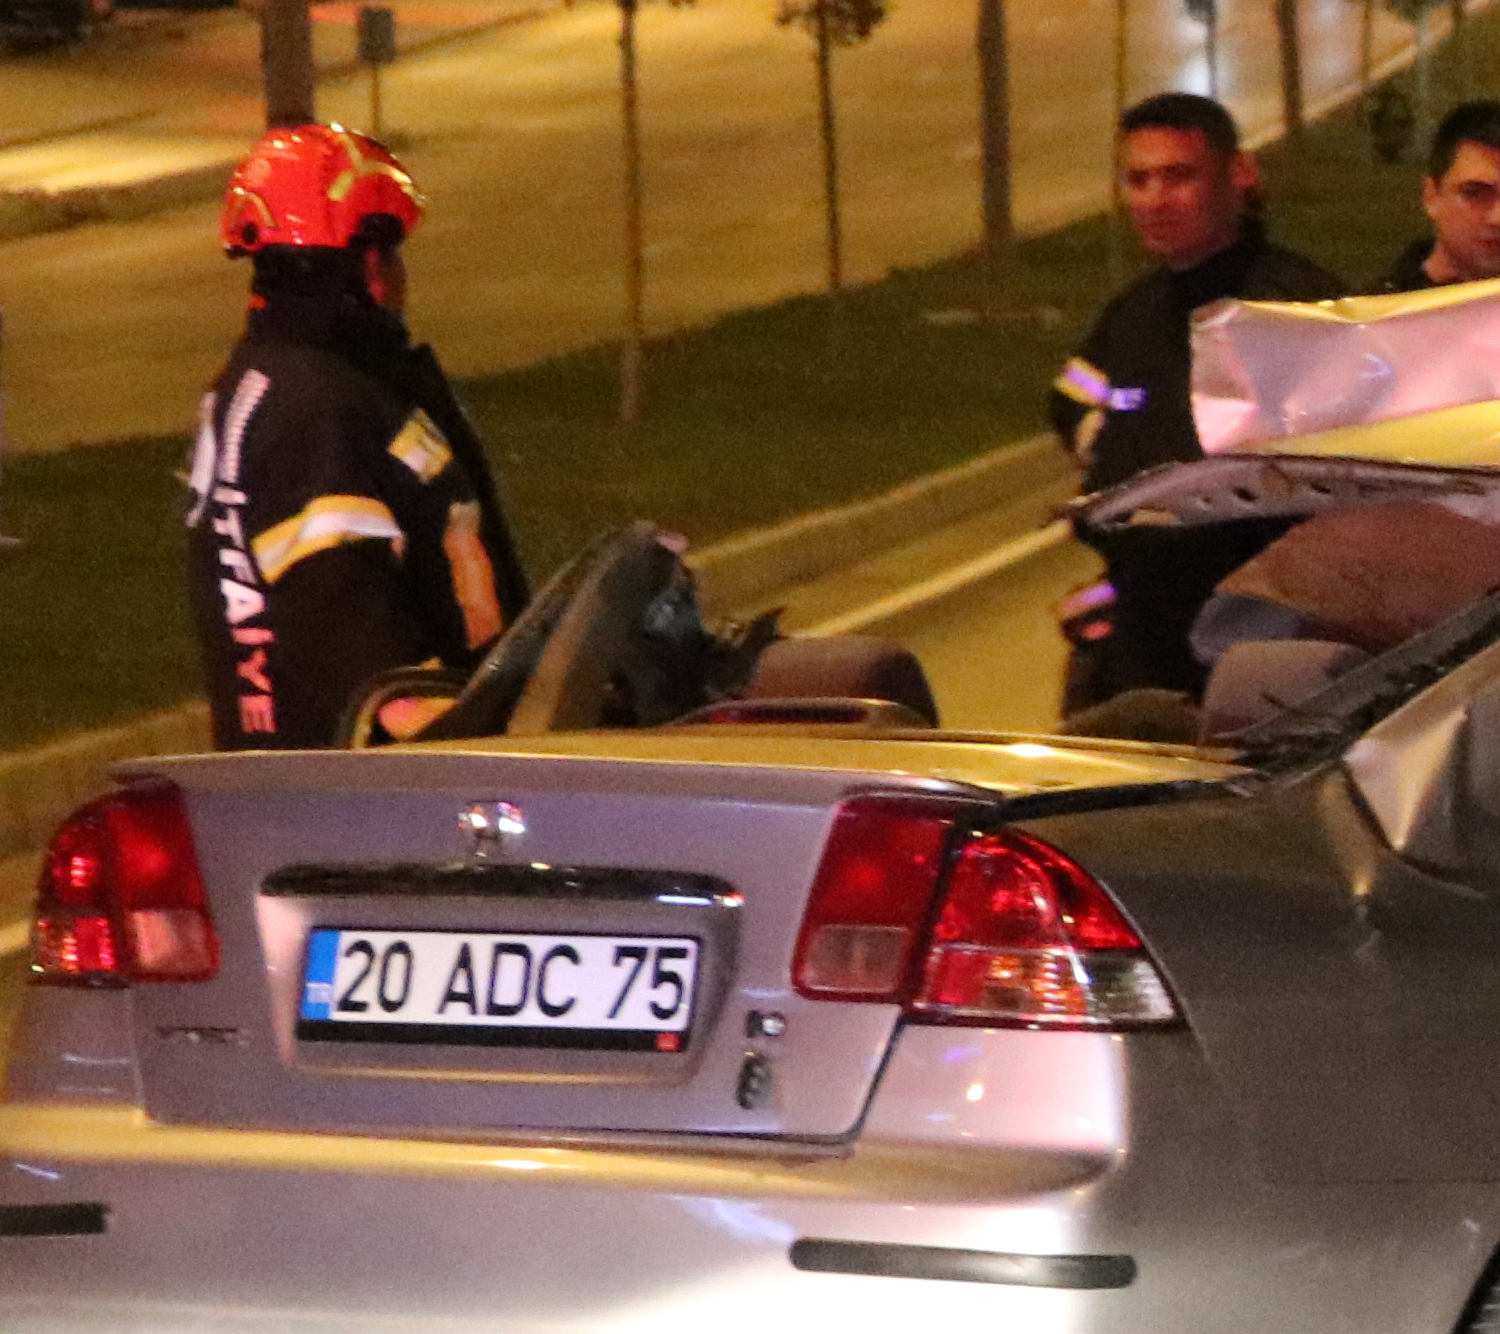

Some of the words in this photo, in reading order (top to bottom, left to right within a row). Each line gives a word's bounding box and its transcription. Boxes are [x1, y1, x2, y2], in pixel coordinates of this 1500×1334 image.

[337, 939, 412, 1013] 20
[437, 942, 581, 1018] ADC
[606, 946, 690, 1021] 75
